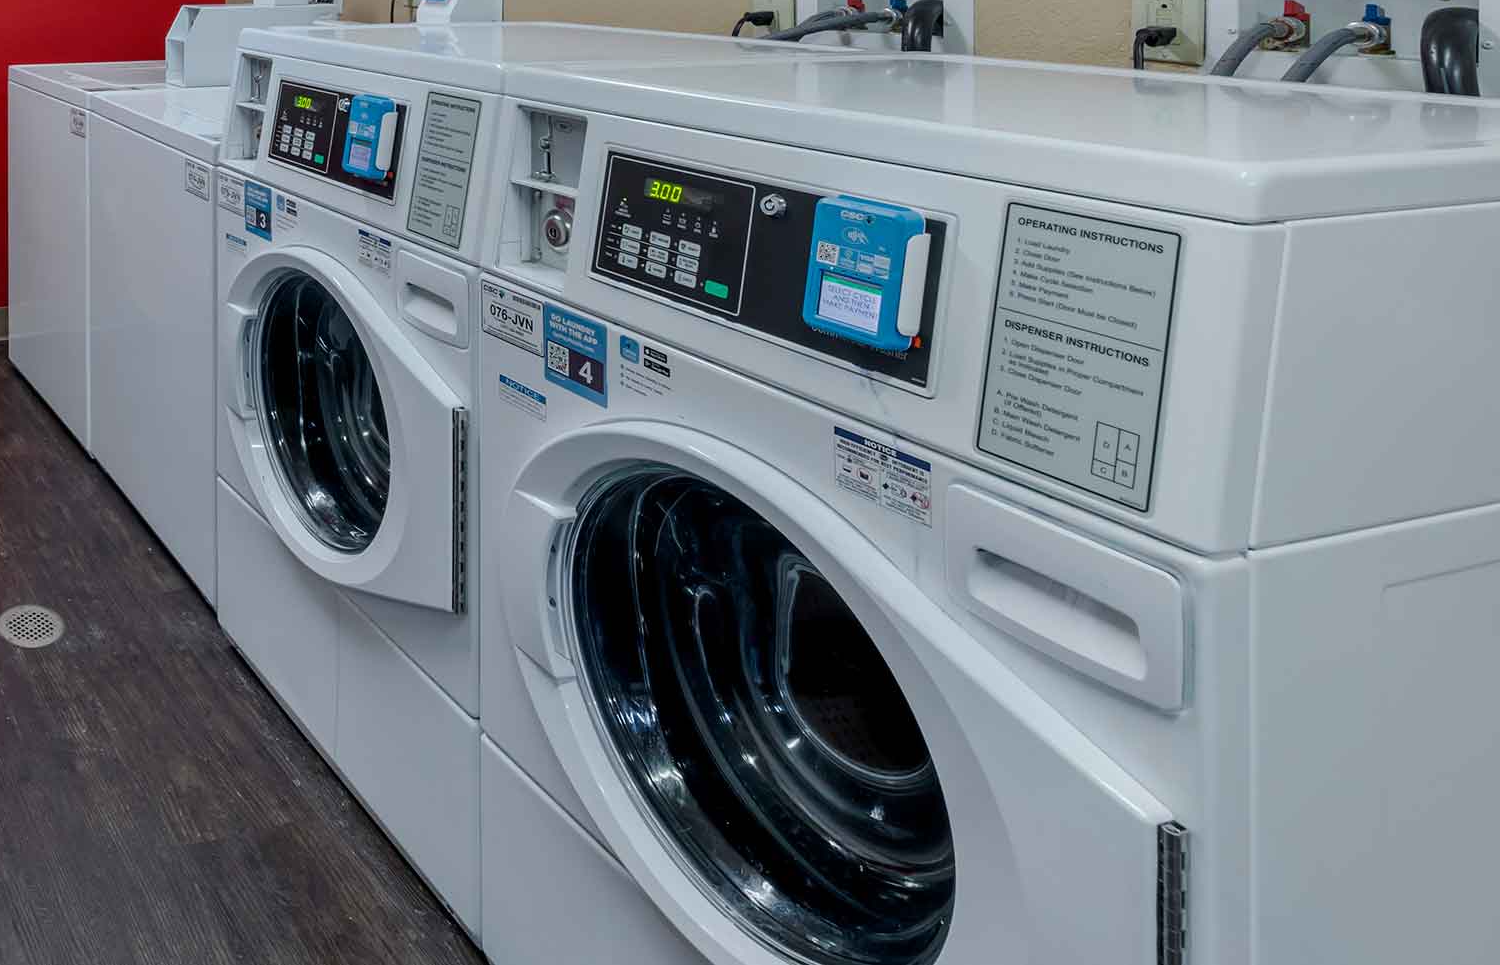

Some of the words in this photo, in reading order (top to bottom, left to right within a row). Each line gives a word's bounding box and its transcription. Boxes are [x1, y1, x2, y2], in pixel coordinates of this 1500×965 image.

[650, 181, 683, 203] 3.00
[260, 213, 266, 228] 3
[840, 210, 865, 221] CSC
[1018, 217, 1077, 236] OPERATING
[1080, 229, 1165, 254] INSTRUCTIONS
[1024, 239, 1041, 248] Load
[1043, 243, 1071, 255] Laundry
[1022, 249, 1043, 259] Close
[1044, 253, 1061, 262] Door
[484, 284, 499, 295] CSC
[1018, 281, 1037, 292] Make
[1038, 286, 1069, 299] Payment
[1020, 271, 1039, 281] Make
[1040, 275, 1060, 286] Cycle
[1061, 279, 1094, 293] Selection
[1021, 260, 1036, 268] Add
[1036, 263, 1066, 276] Supplies
[1066, 270, 1084, 281] (See
[1085, 275, 1128, 291] Instructions
[1129, 284, 1156, 299] Below)
[490, 304, 533, 332] 076-JVN
[1017, 292, 1037, 303] Press
[1038, 297, 1054, 307] Start
[1055, 301, 1076, 313] (Door
[1077, 306, 1095, 318] Must
[1107, 314, 1138, 330] Closed)
[549, 321, 568, 332] WITH
[569, 328, 582, 338] THE
[584, 334, 598, 345] APP
[562, 317, 596, 336] LAUNDRY
[1004, 319, 1064, 343] DISPENSER
[1065, 336, 1150, 367] INSTRUCTIONS
[1011, 339, 1030, 351] Open
[1031, 344, 1066, 361] Dispenser
[1067, 355, 1085, 365] Door
[579, 361, 593, 384] 4
[1009, 350, 1028, 361] Load
[1028, 357, 1057, 372] Supplies
[1066, 367, 1092, 382] Proper
[505, 378, 543, 401] NOTICE
[1008, 367, 1027, 379] Close
[1028, 373, 1062, 391] Dispenser
[1063, 385, 1082, 396] Door
[1019, 395, 1040, 408] Wash
[1042, 402, 1079, 421] Detergent
[1001, 421, 1024, 436] Liquid
[1025, 428, 1051, 443] Bleach
[1003, 409, 1021, 422] Main
[1021, 416, 1043, 429] Wash
[1043, 423, 1081, 442] Detergent
[864, 439, 897, 456] NOTICE
[1001, 431, 1023, 445] Fabric
[1024, 439, 1055, 457] Softener
[1103, 440, 1111, 449] D
[1123, 443, 1132, 452] A
[1100, 466, 1108, 475] C
[1121, 469, 1129, 478] B
